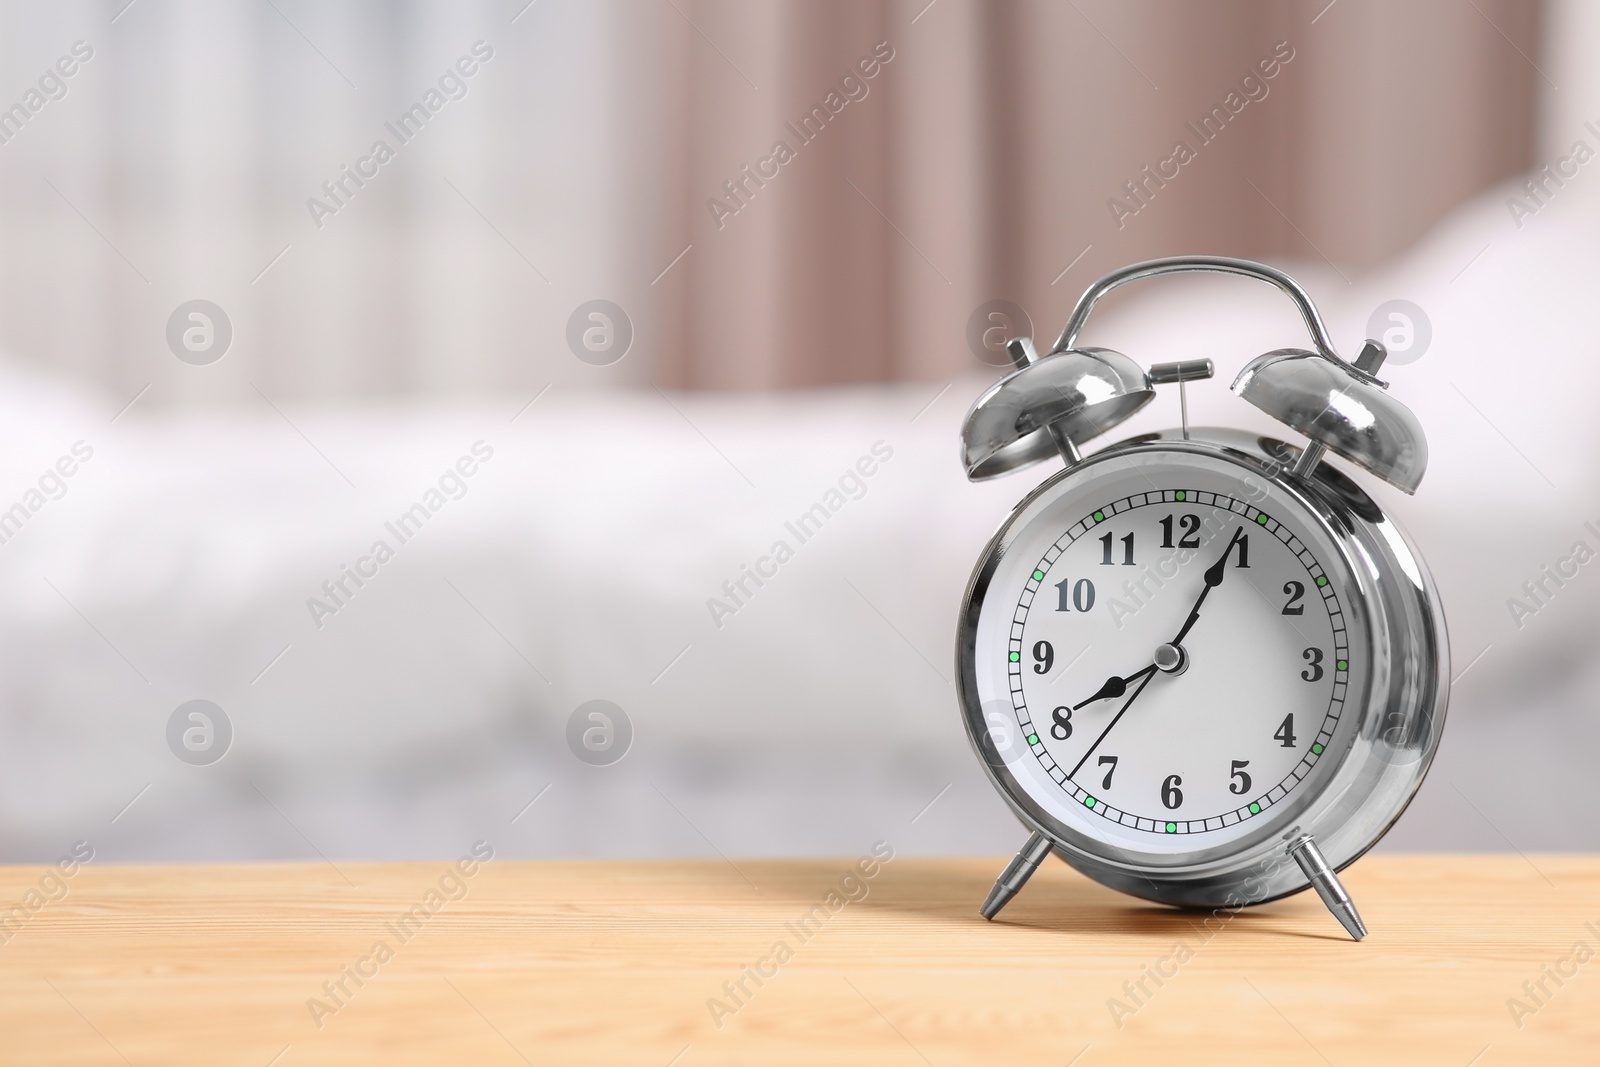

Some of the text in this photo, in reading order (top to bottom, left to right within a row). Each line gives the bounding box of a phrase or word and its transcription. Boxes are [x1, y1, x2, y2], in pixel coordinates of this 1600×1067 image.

[1159, 514, 1201, 548] 12
[1099, 532, 1136, 565] 11
[1235, 534, 1250, 568] 1
[1055, 579, 1095, 612] 10
[1282, 581, 1305, 615] 2
[1033, 640, 1054, 675] 9
[1301, 647, 1323, 682] 3
[1051, 706, 1073, 740] 8
[1274, 713, 1296, 747] 4
[1098, 756, 1118, 790] 7
[1230, 760, 1251, 794] 5
[1161, 775, 1183, 809] 6
